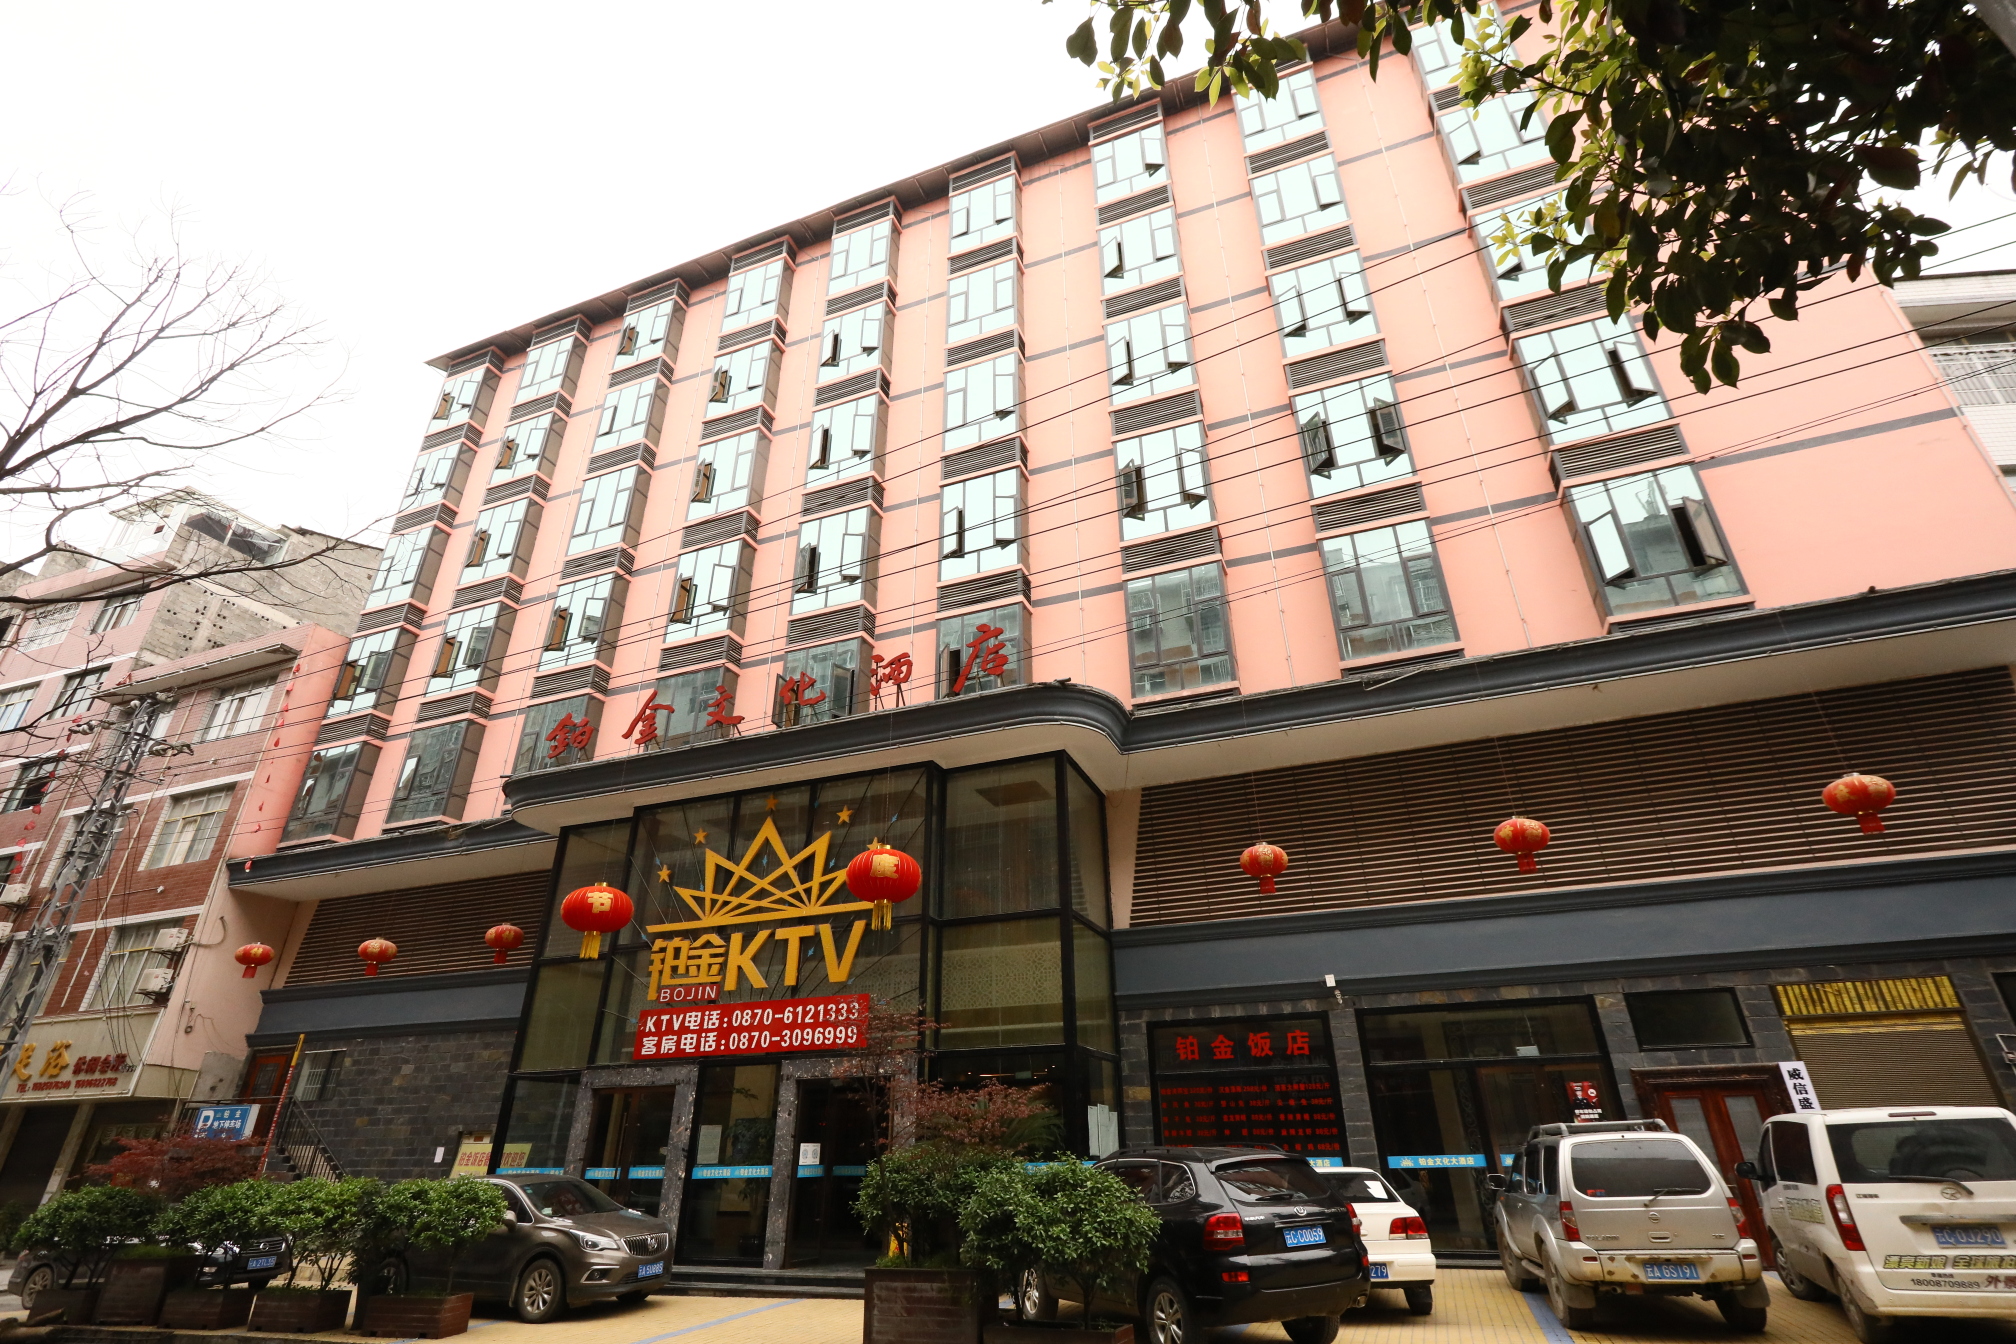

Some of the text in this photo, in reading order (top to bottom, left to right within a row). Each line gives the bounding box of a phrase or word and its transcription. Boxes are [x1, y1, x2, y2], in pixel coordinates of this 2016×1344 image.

[659, 985, 718, 1003] BOJIN
[640, 1025, 858, 1056] 客房电话:0870-3096999
[1175, 1029, 1311, 1062] 铂金饭店
[1786, 1067, 1816, 1111] 威信盛
[1309, 1159, 1331, 1168] 大酒店
[1418, 1157, 1475, 1167] 铂金文化大酒店
[1370, 1265, 1388, 1277] 279
